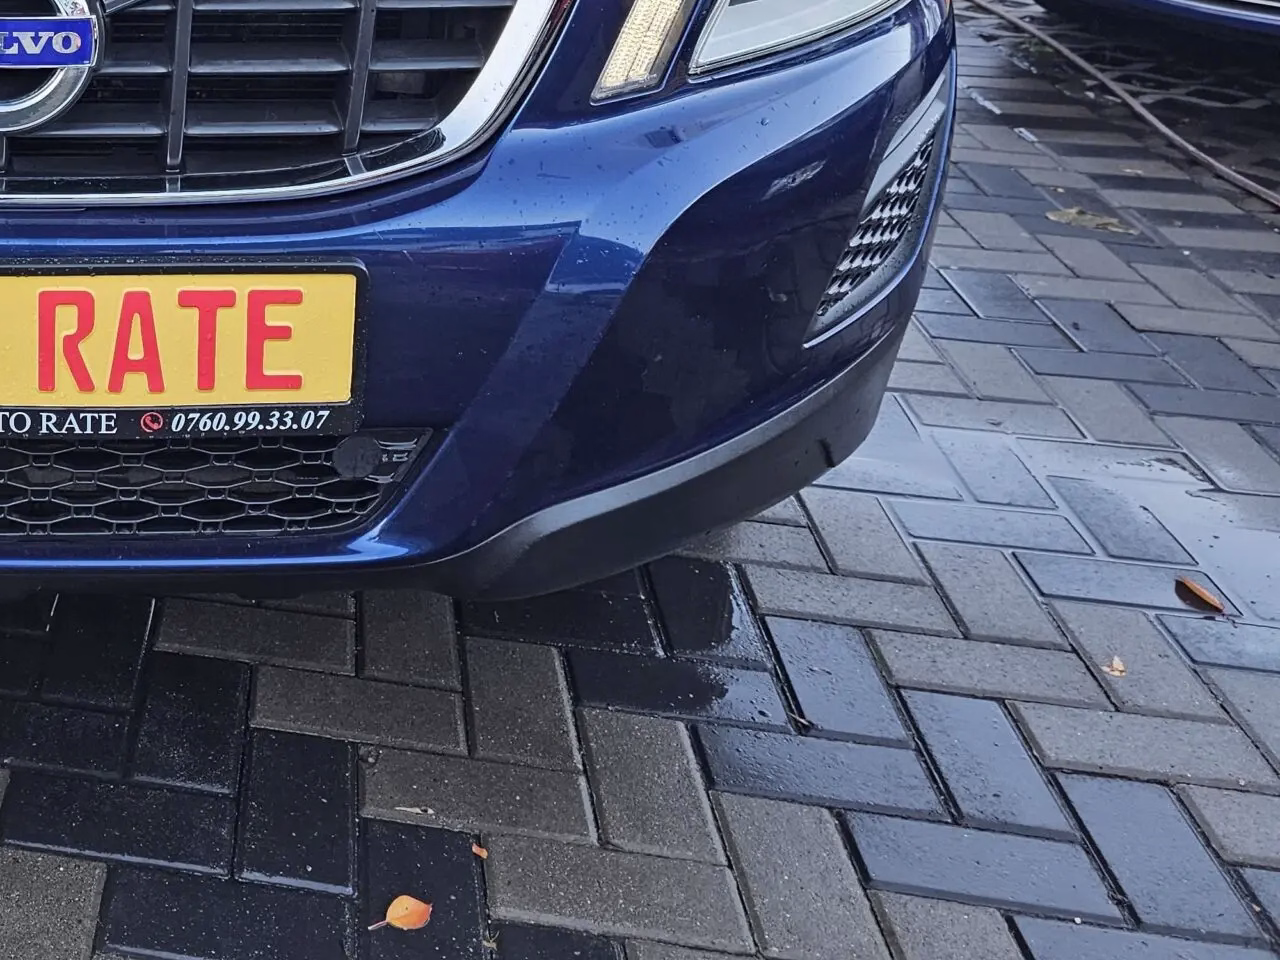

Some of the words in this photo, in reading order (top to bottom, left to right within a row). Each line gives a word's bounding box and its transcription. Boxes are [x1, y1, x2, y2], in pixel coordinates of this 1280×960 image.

[38, 290, 304, 393] RATE
[39, 412, 118, 434] RATE
[170, 410, 331, 432] 0760.99.33.07
